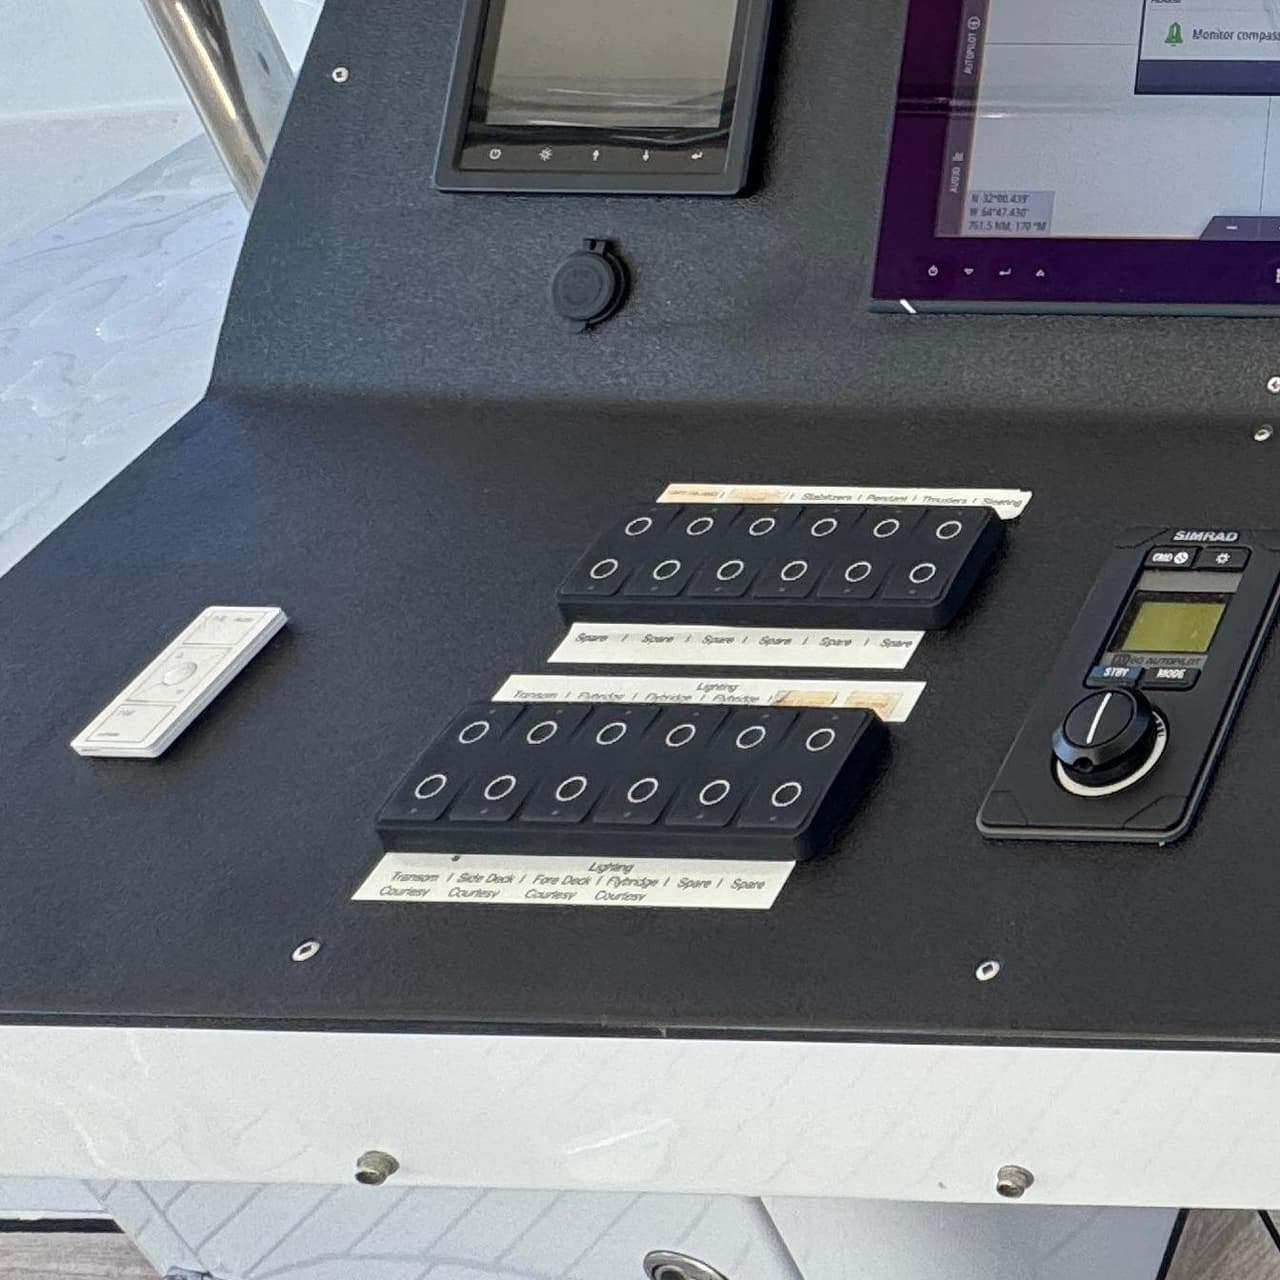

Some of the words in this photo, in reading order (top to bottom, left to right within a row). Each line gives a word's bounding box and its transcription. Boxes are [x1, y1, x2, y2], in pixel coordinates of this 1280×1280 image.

[1192, 28, 1234, 41] Monitor
[1172, 530, 1239, 542] SIMRAD
[574, 632, 608, 642] Spare
[640, 633, 674, 644] Spare
[701, 635, 735, 645] Spare
[758, 636, 792, 646] Spare
[818, 637, 852, 647] Spare
[879, 638, 913, 648] Spare
[696, 682, 739, 693] Lighting
[588, 861, 634, 875] Lighting
[485, 873, 513, 884] Deck
[561, 875, 591, 886] Deck
[606, 876, 659, 889] Flybridge
[677, 877, 712, 890] Spare
[730, 878, 766, 891] Spare
[379, 885, 431, 898] Courtesy
[448, 886, 500, 899] Courtesy
[524, 888, 578, 900] Courtesy
[594, 890, 647, 902] Courtesy
